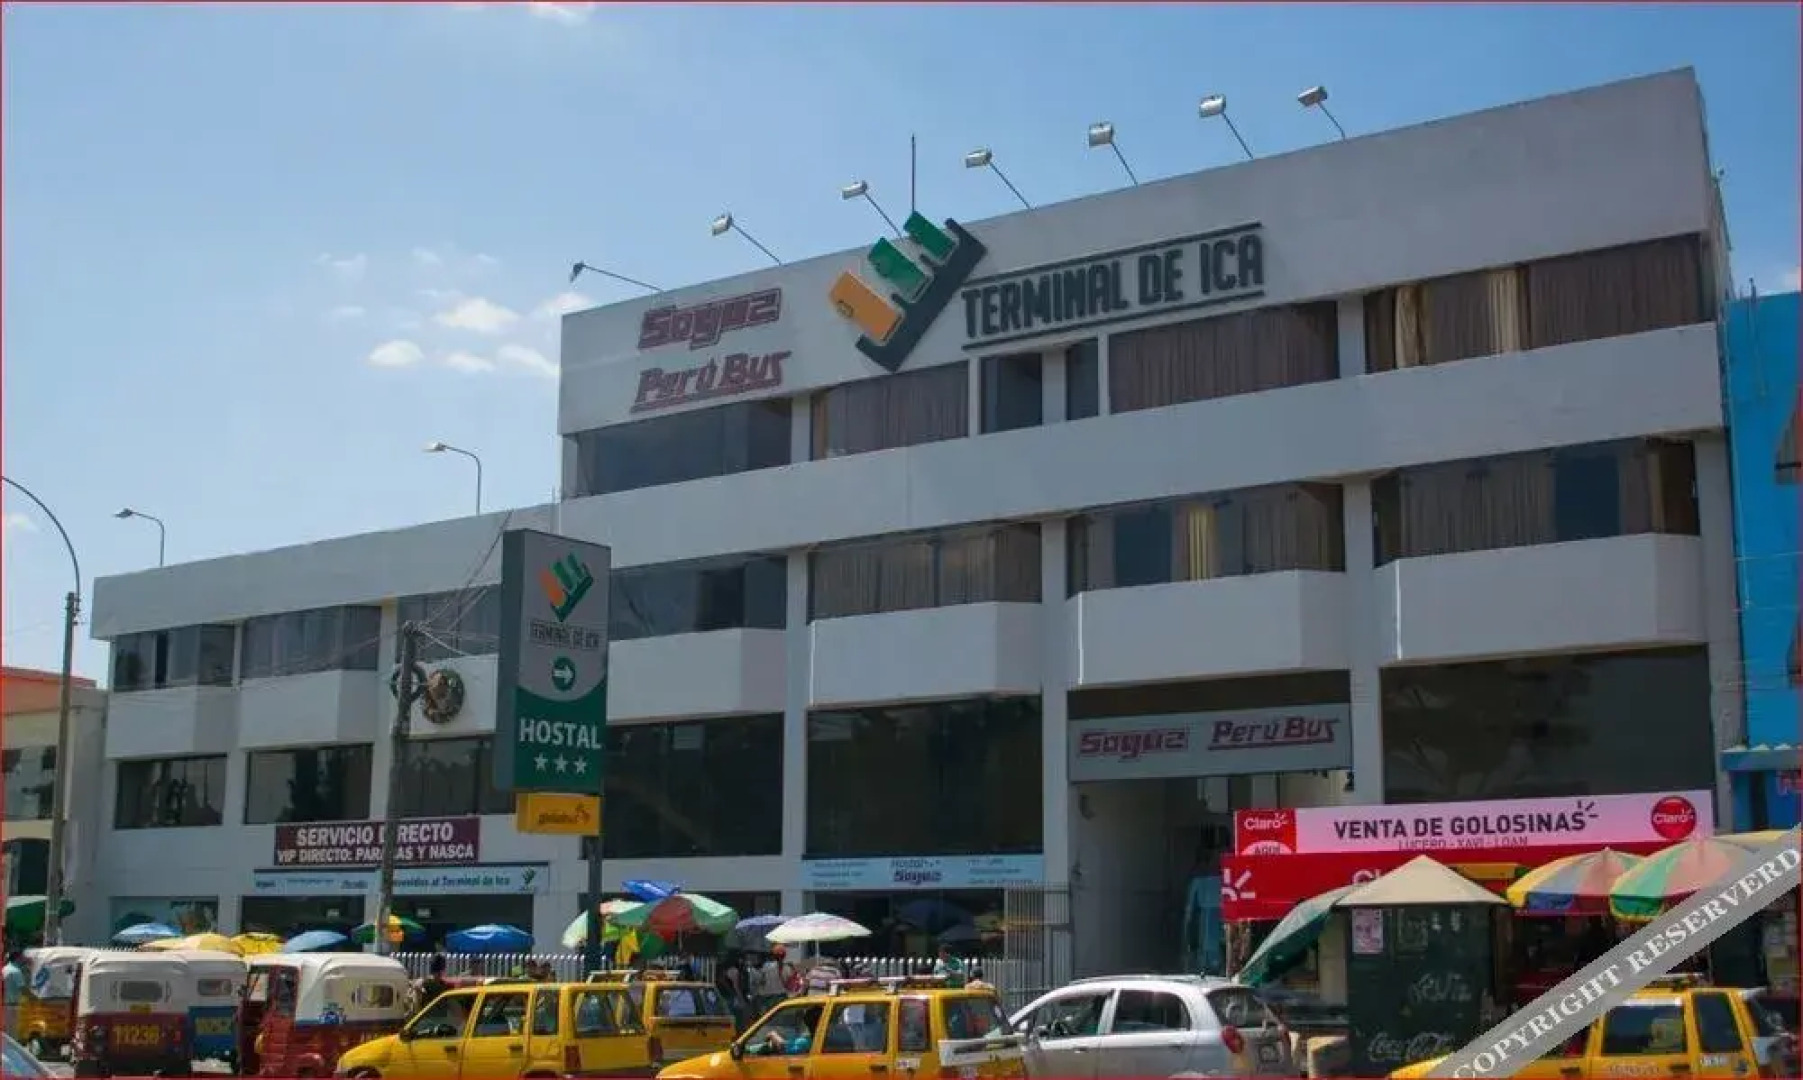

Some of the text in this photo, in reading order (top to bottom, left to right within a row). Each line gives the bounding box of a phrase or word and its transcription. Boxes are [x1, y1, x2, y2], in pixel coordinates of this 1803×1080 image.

[962, 233, 1265, 338] TERMINAL DE ICA
[637, 289, 781, 351] Soyuz
[719, 350, 792, 397] Bus
[518, 717, 603, 750] HOSTAL
[1282, 716, 1341, 744] Bus
[1079, 728, 1189, 762] Soyuz
[1243, 816, 1283, 831] Claro
[1333, 810, 1586, 839] VENTA DE GOLOSINAS
[1652, 812, 1691, 826] Claro
[296, 825, 374, 847] SERVICIO
[277, 848, 297, 863] VIP
[298, 848, 353, 863] DIRECTO:
[417, 845, 427, 860] Y
[428, 843, 475, 859] NASCA
